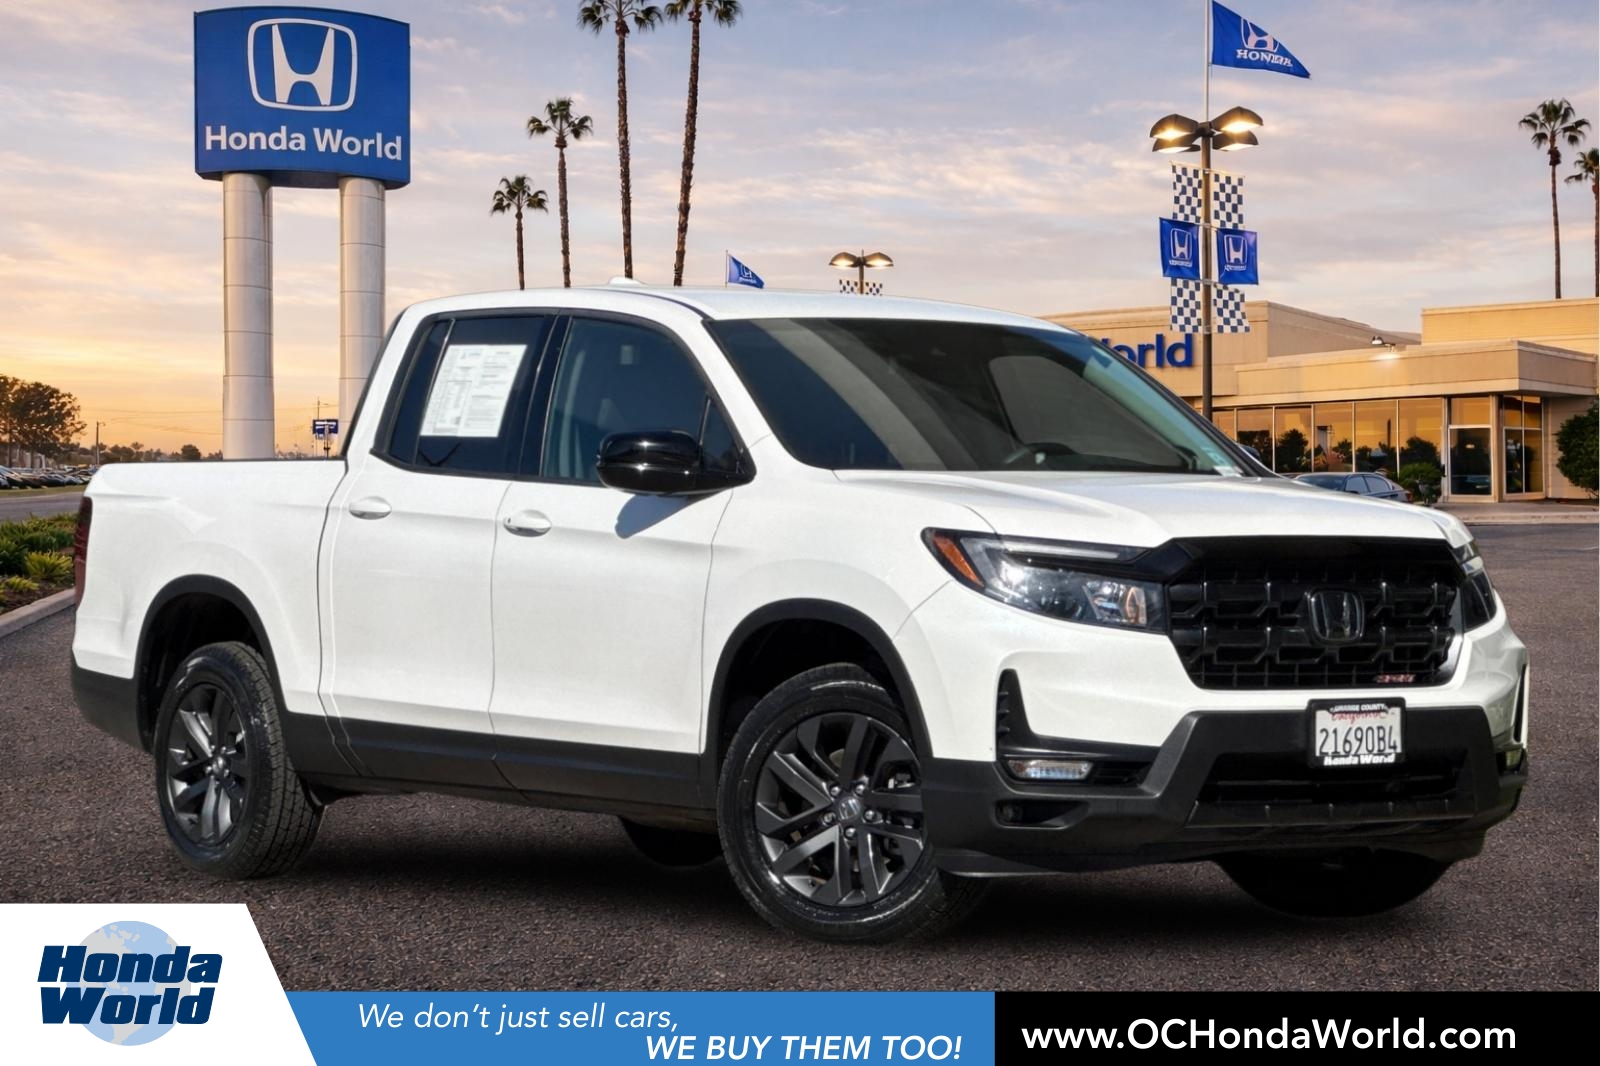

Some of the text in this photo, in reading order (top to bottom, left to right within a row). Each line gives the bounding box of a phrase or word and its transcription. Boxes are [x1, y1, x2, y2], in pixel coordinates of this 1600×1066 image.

[205, 125, 402, 160] Honda World
[1101, 333, 1194, 368] orld
[1319, 725, 1398, 756] 21690B4
